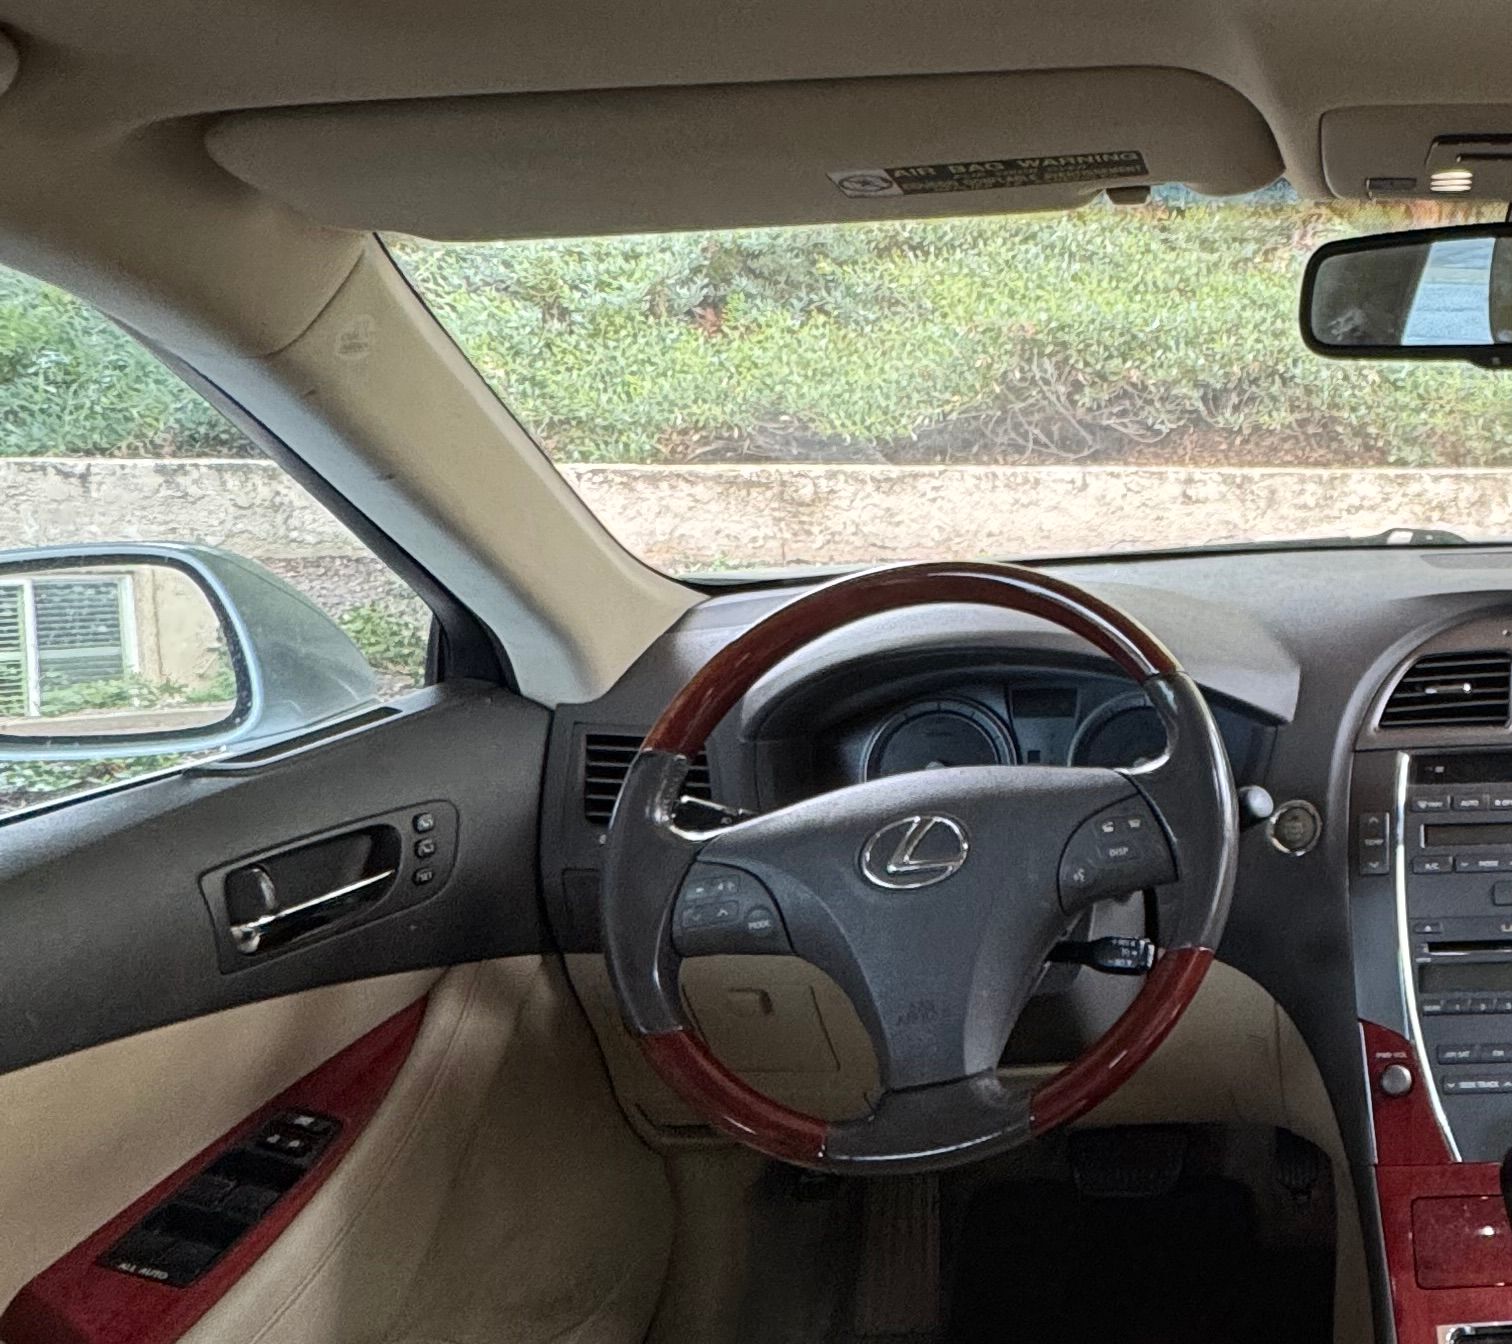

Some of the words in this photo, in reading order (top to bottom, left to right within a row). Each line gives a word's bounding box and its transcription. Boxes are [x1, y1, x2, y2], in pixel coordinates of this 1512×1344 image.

[894, 166, 937, 179] AIR
[949, 160, 1004, 173] BAG
[1014, 151, 1139, 169] WARNING
[1460, 799, 1480, 807] AUTO
[1109, 847, 1129, 857] DISP
[747, 920, 771, 930] MODE
[118, 1262, 137, 1274] ALL
[138, 1267, 169, 1280] AUTO
